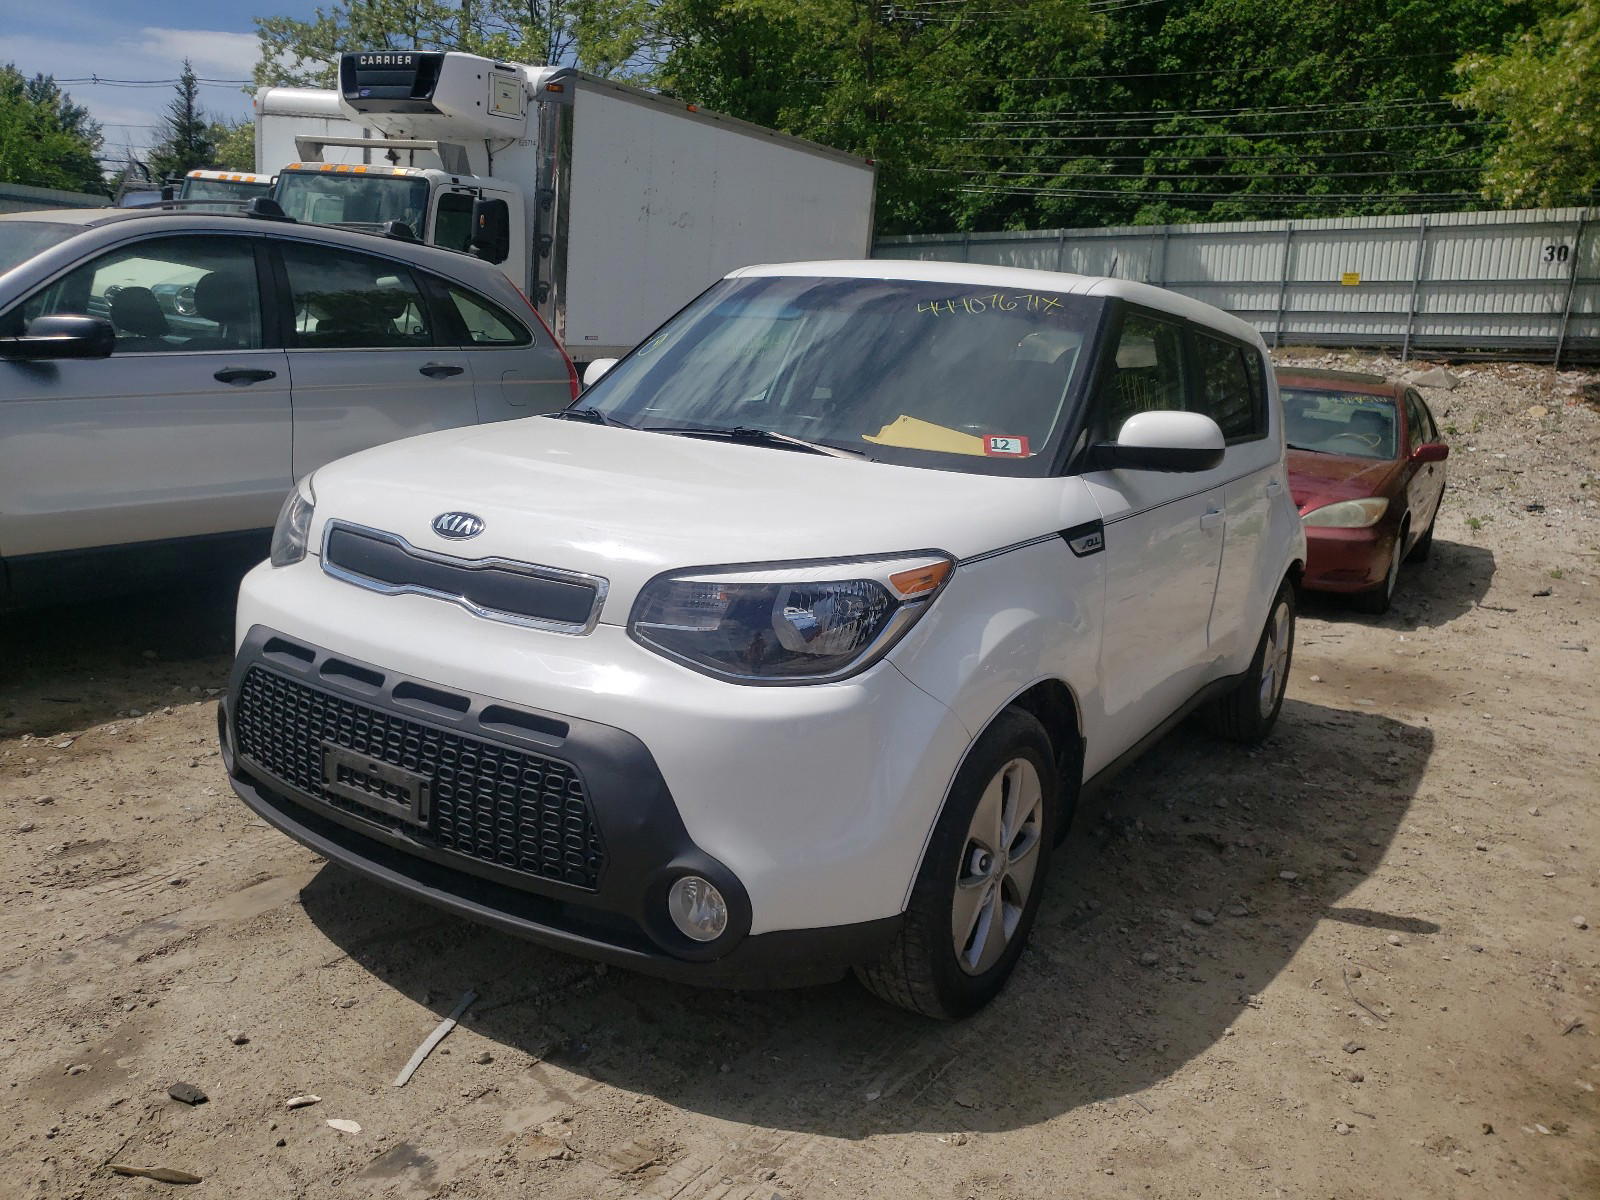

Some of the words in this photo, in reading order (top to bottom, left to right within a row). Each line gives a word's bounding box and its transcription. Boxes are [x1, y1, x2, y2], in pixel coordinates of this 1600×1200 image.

[360, 55, 412, 65] CARRIER
[1544, 245, 1569, 262] 30
[991, 438, 1011, 451] 12
[436, 513, 475, 535] KIA
